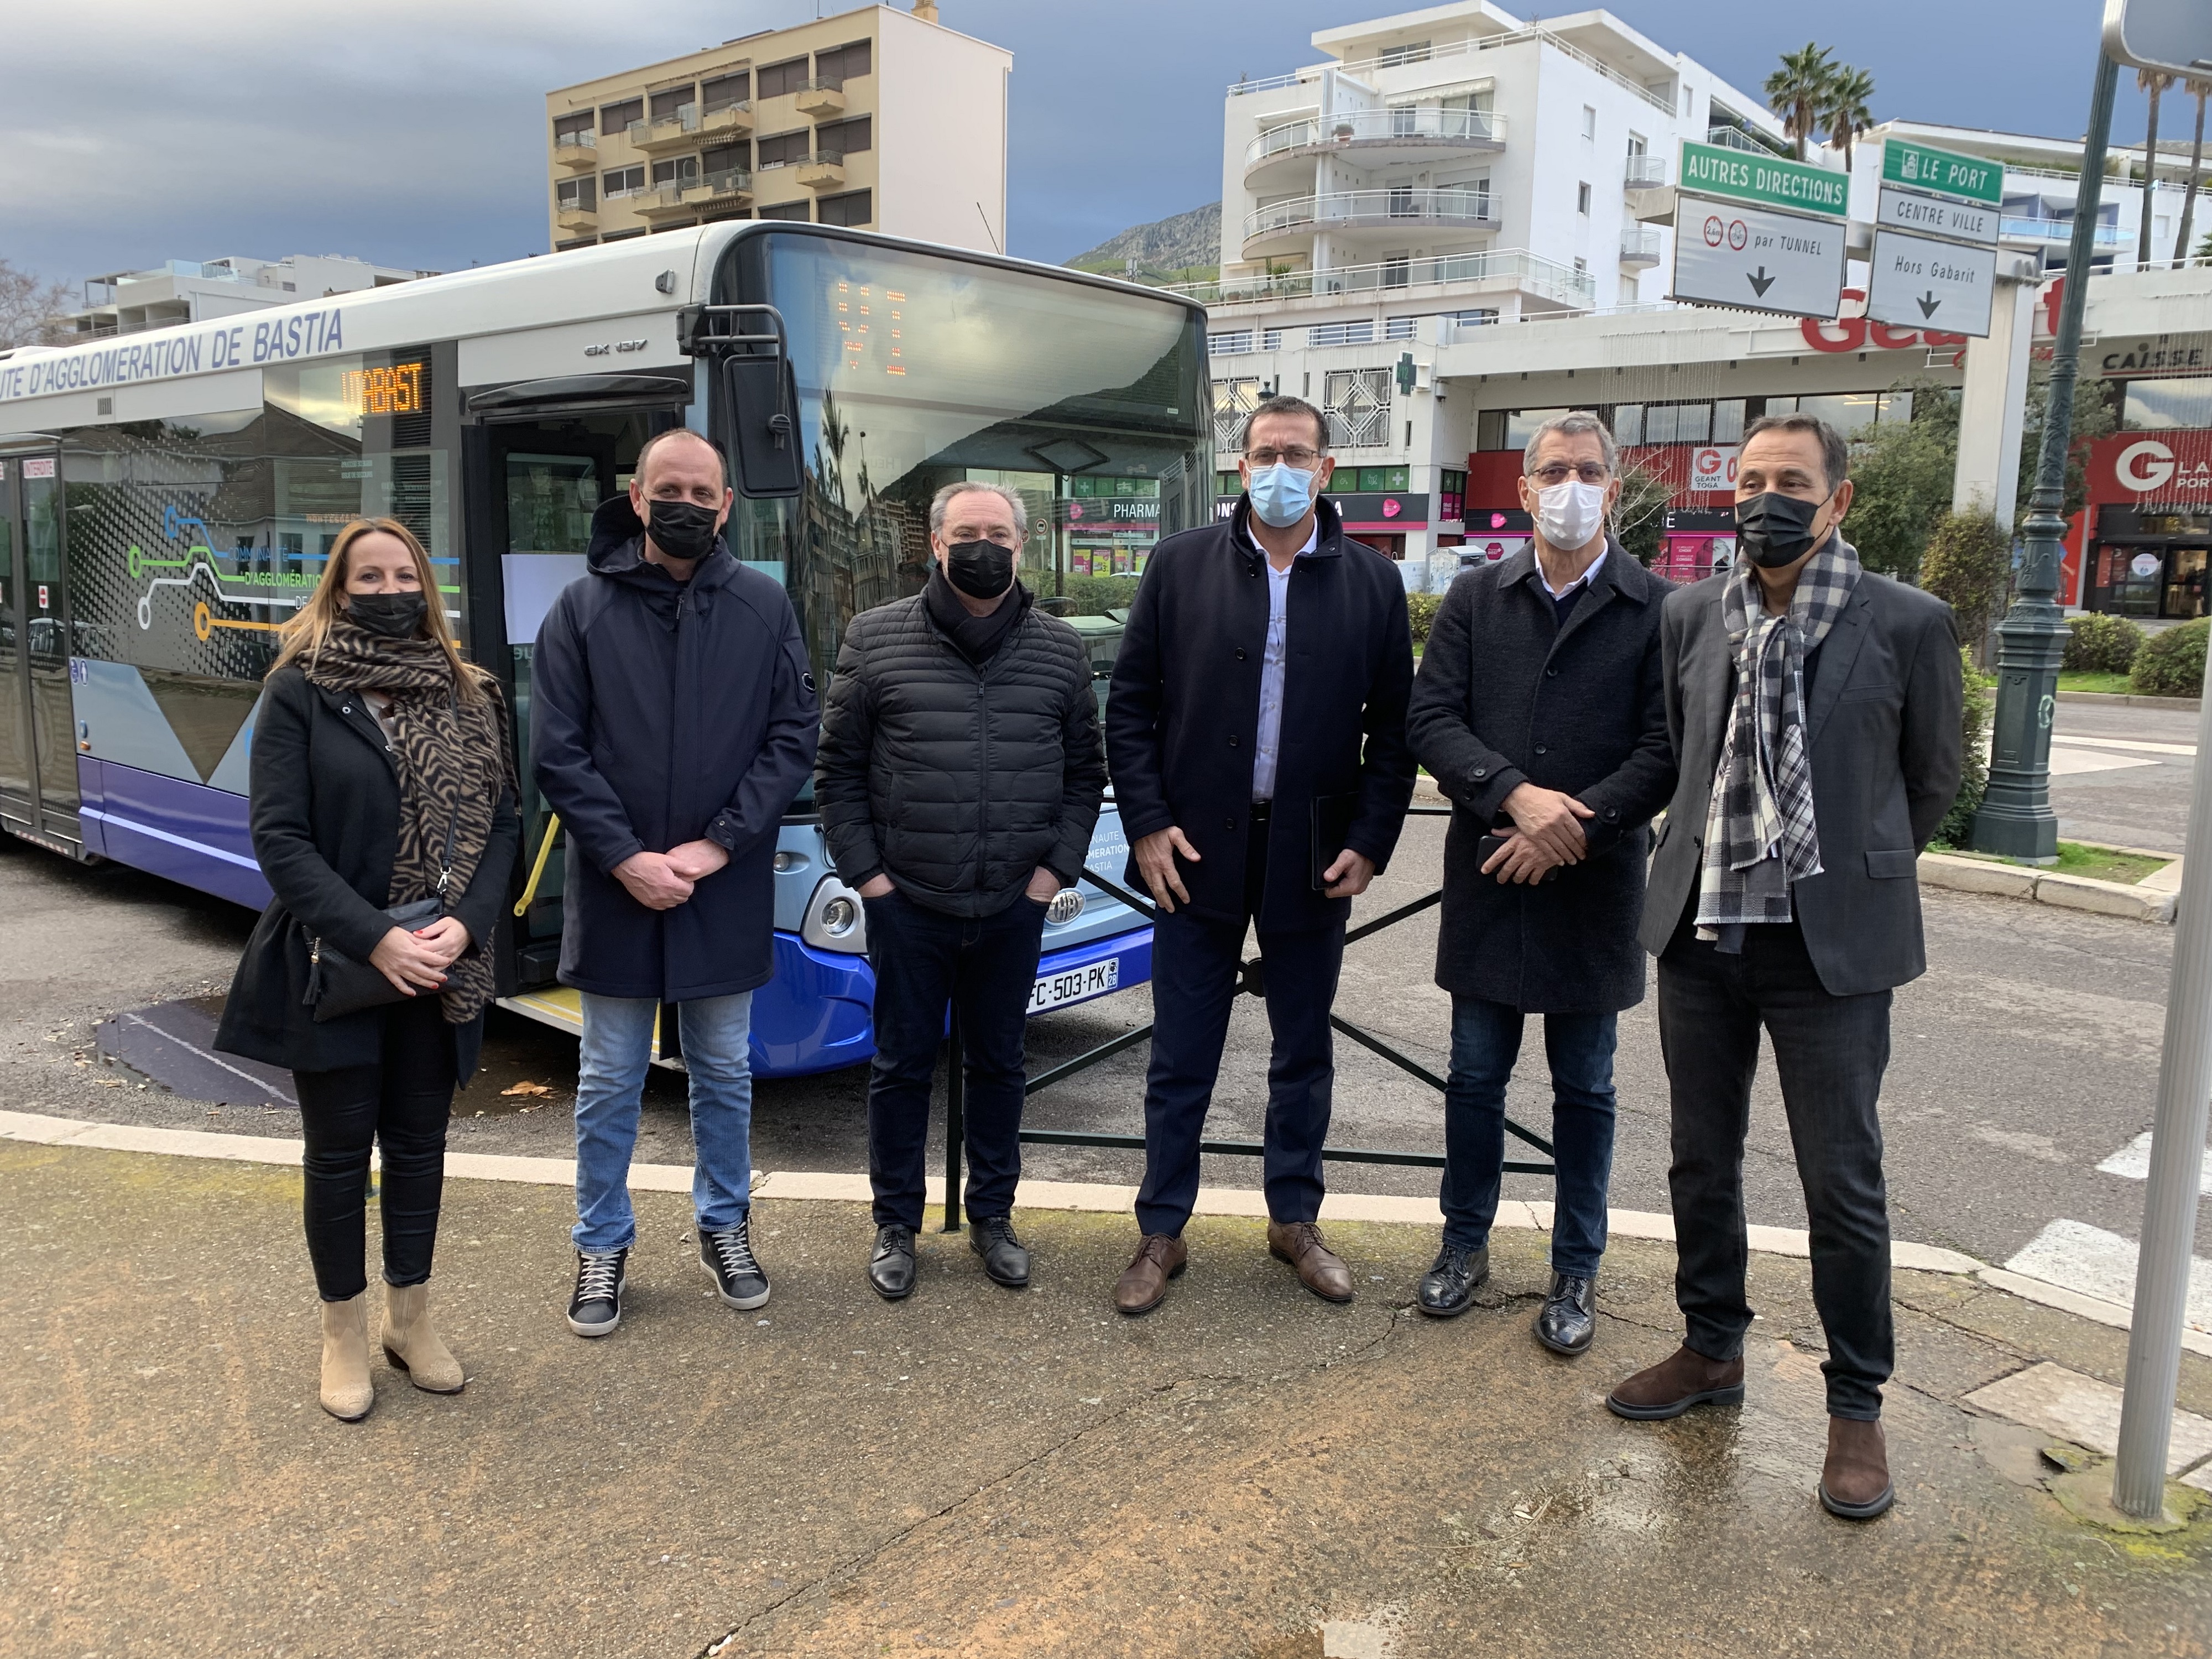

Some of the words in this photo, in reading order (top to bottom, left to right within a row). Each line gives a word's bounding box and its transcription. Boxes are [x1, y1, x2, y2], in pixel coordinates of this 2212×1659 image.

[1688, 154, 1749, 187] AUTRES
[1756, 168, 1843, 205] DIRECTIONS
[1922, 157, 1940, 180] LE
[1948, 164, 1989, 190] PORT
[1897, 201, 1944, 225] CENTRE
[1953, 211, 1984, 232] VILLE
[1754, 236, 1774, 249] par
[1781, 236, 1822, 255] TUNNEL
[1895, 255, 1922, 275] Hors
[1931, 261, 1975, 283] Gabarit
[29, 333, 202, 394] D'AGGLOMERATION
[211, 326, 244, 369] DE
[253, 307, 342, 363] BASTIA
[584, 343, 609, 356] GX
[614, 338, 648, 352] 137
[2176, 477, 2212, 488] POR
[244, 569, 322, 588] D'AGGLOMÉRATIO
[1090, 831, 1119, 845] NAUTE
[1086, 843, 1130, 859] MERATION
[1108, 975, 1117, 986] 2B
